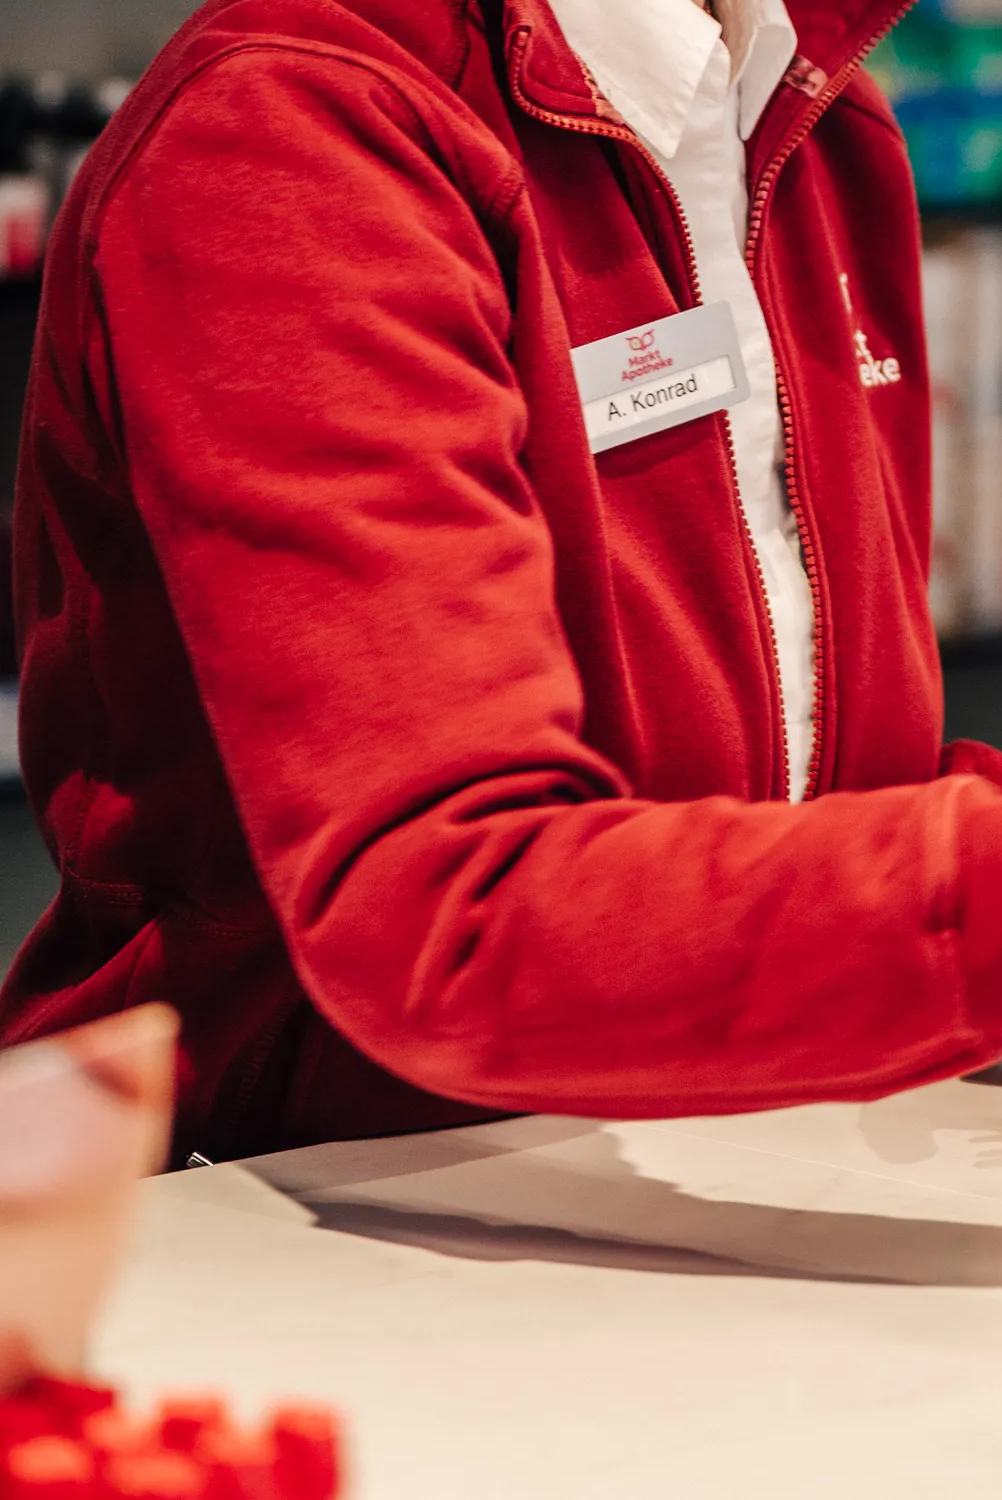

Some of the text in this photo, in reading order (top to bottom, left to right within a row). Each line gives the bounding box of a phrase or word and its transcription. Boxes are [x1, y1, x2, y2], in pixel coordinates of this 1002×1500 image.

[621, 356, 673, 381] Apotheke
[628, 350, 660, 367] Markt
[607, 373, 698, 421] A. Konrad
